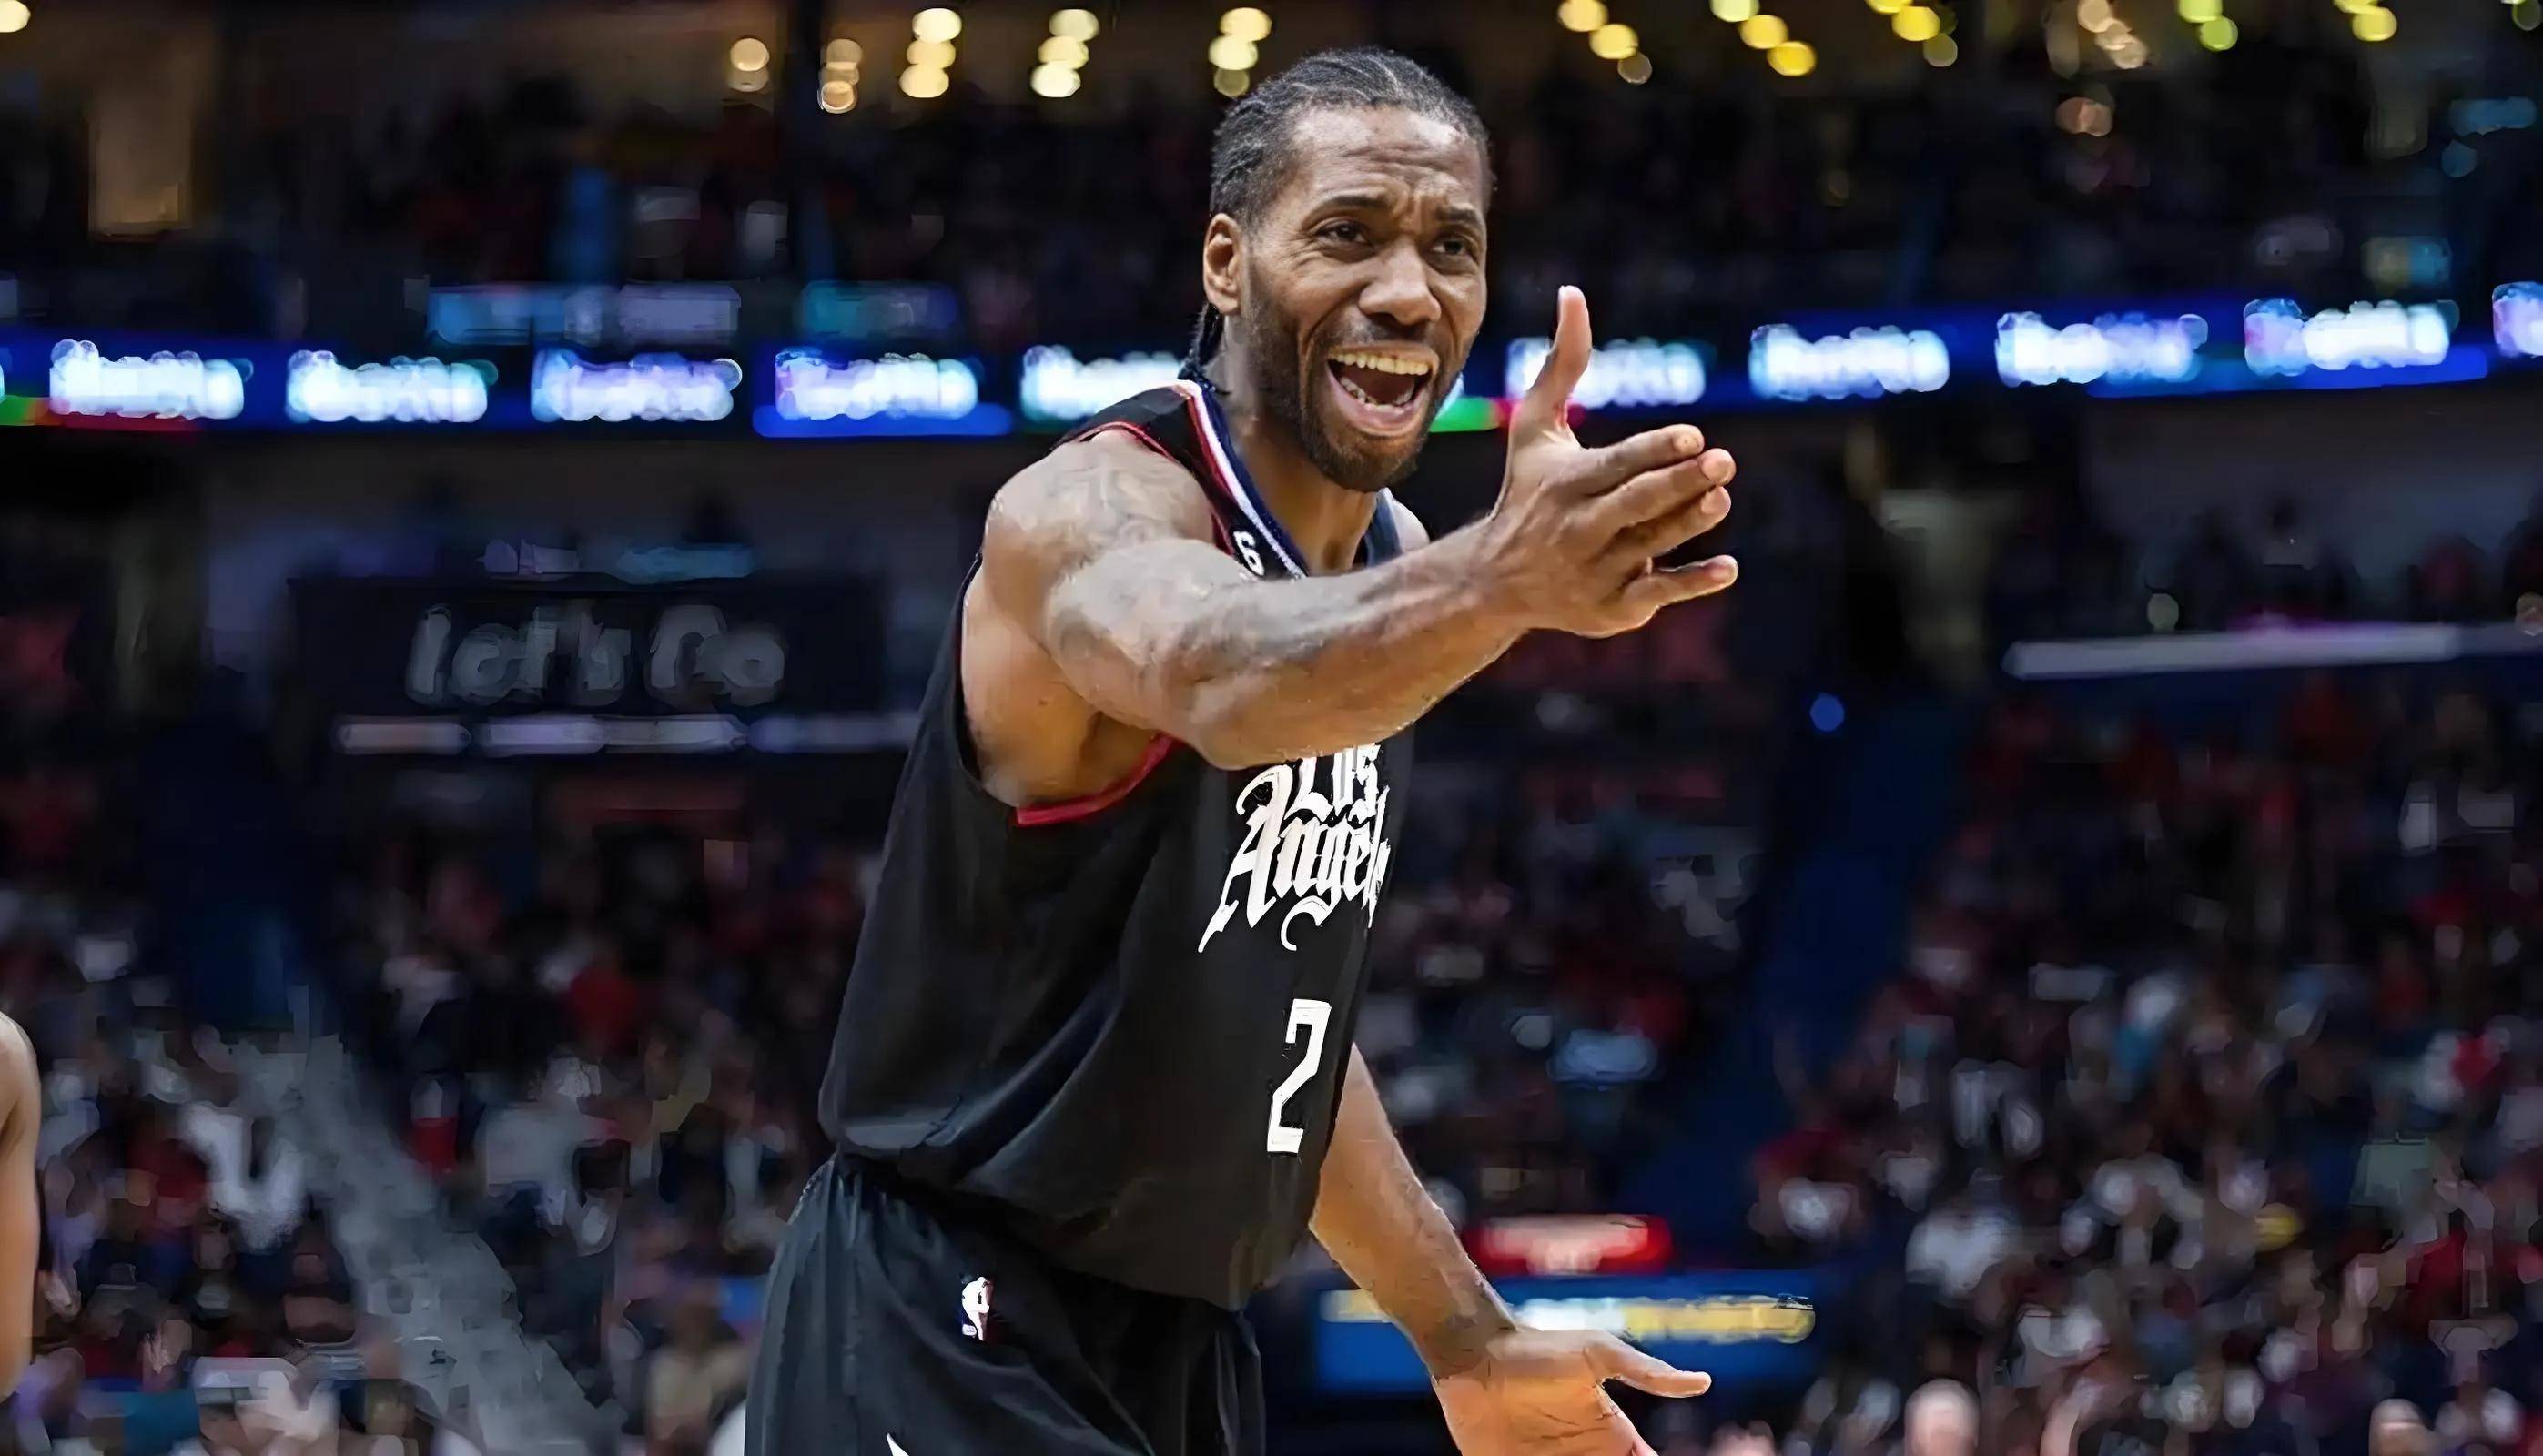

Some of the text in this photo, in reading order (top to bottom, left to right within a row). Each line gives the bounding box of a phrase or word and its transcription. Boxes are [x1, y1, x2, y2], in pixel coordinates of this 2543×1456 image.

[1233, 531, 1265, 576] 6
[1198, 764, 1392, 953] Angel
[1267, 998, 1332, 1154] 2
